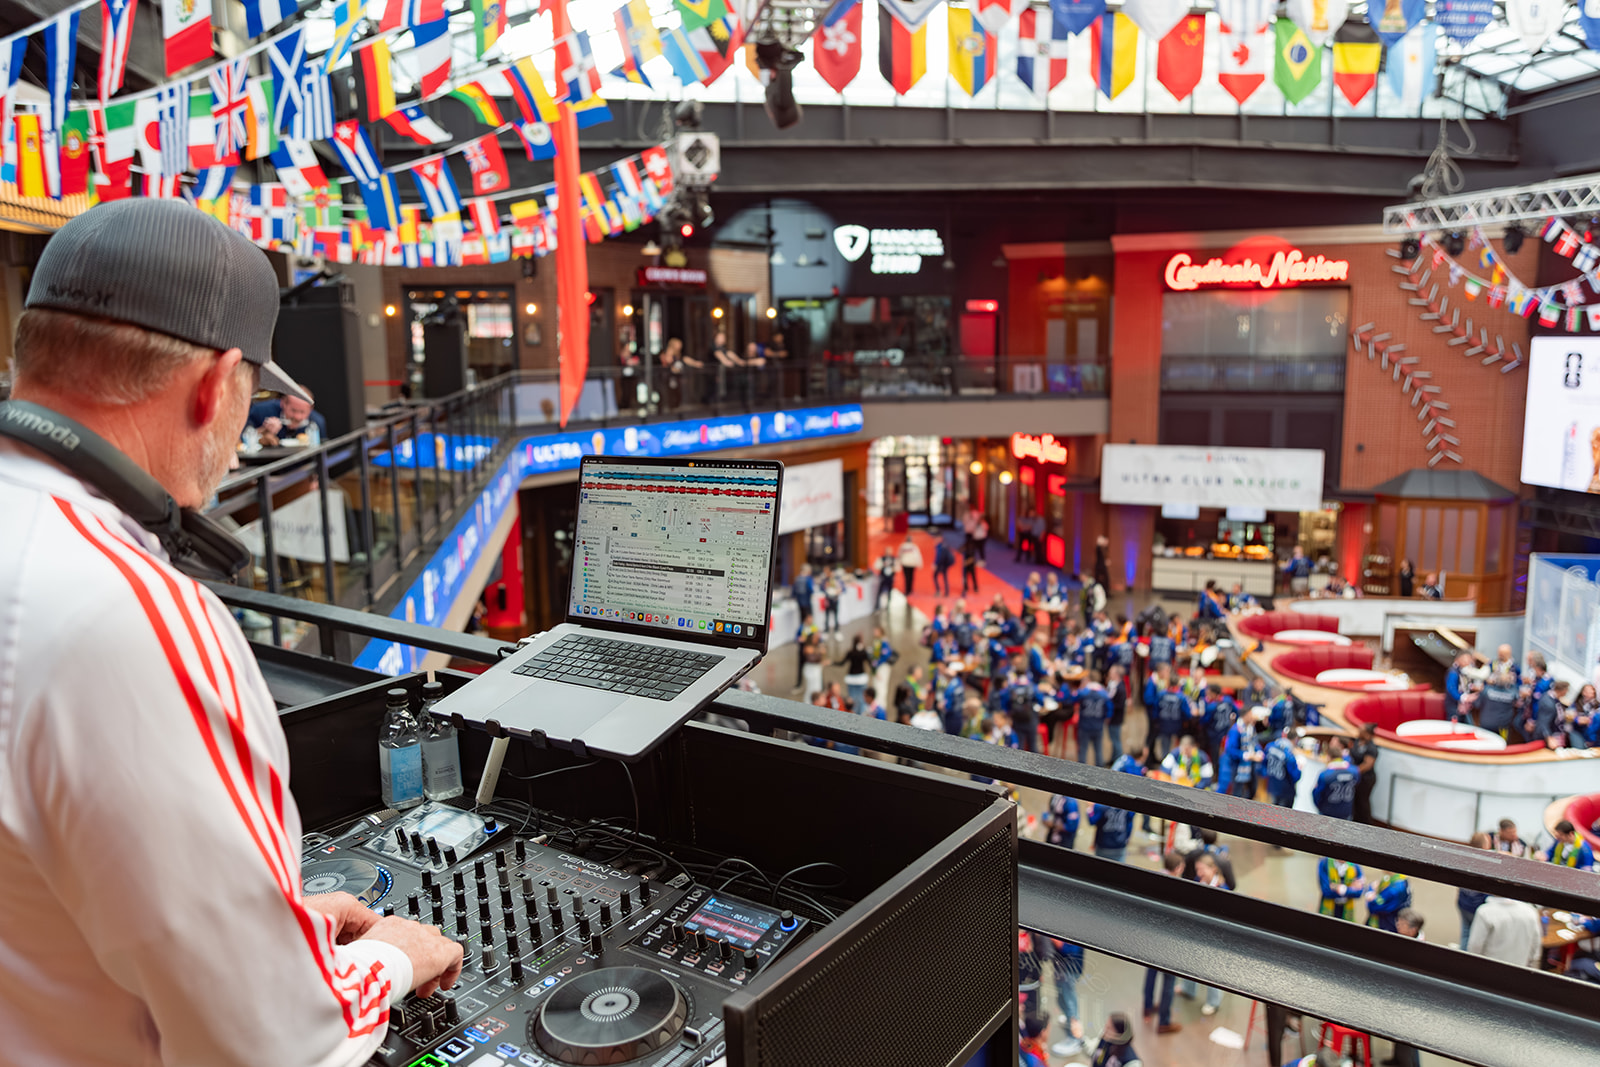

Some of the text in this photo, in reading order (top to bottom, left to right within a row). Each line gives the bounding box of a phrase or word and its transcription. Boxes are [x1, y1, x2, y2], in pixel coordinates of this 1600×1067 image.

[1164, 249, 1349, 290] Cardinals Nation
[532, 441, 582, 460] ULTRA
[1121, 473, 1301, 490] ULTRA CLUB MEXICO
[557, 853, 632, 881] DENON DJ
